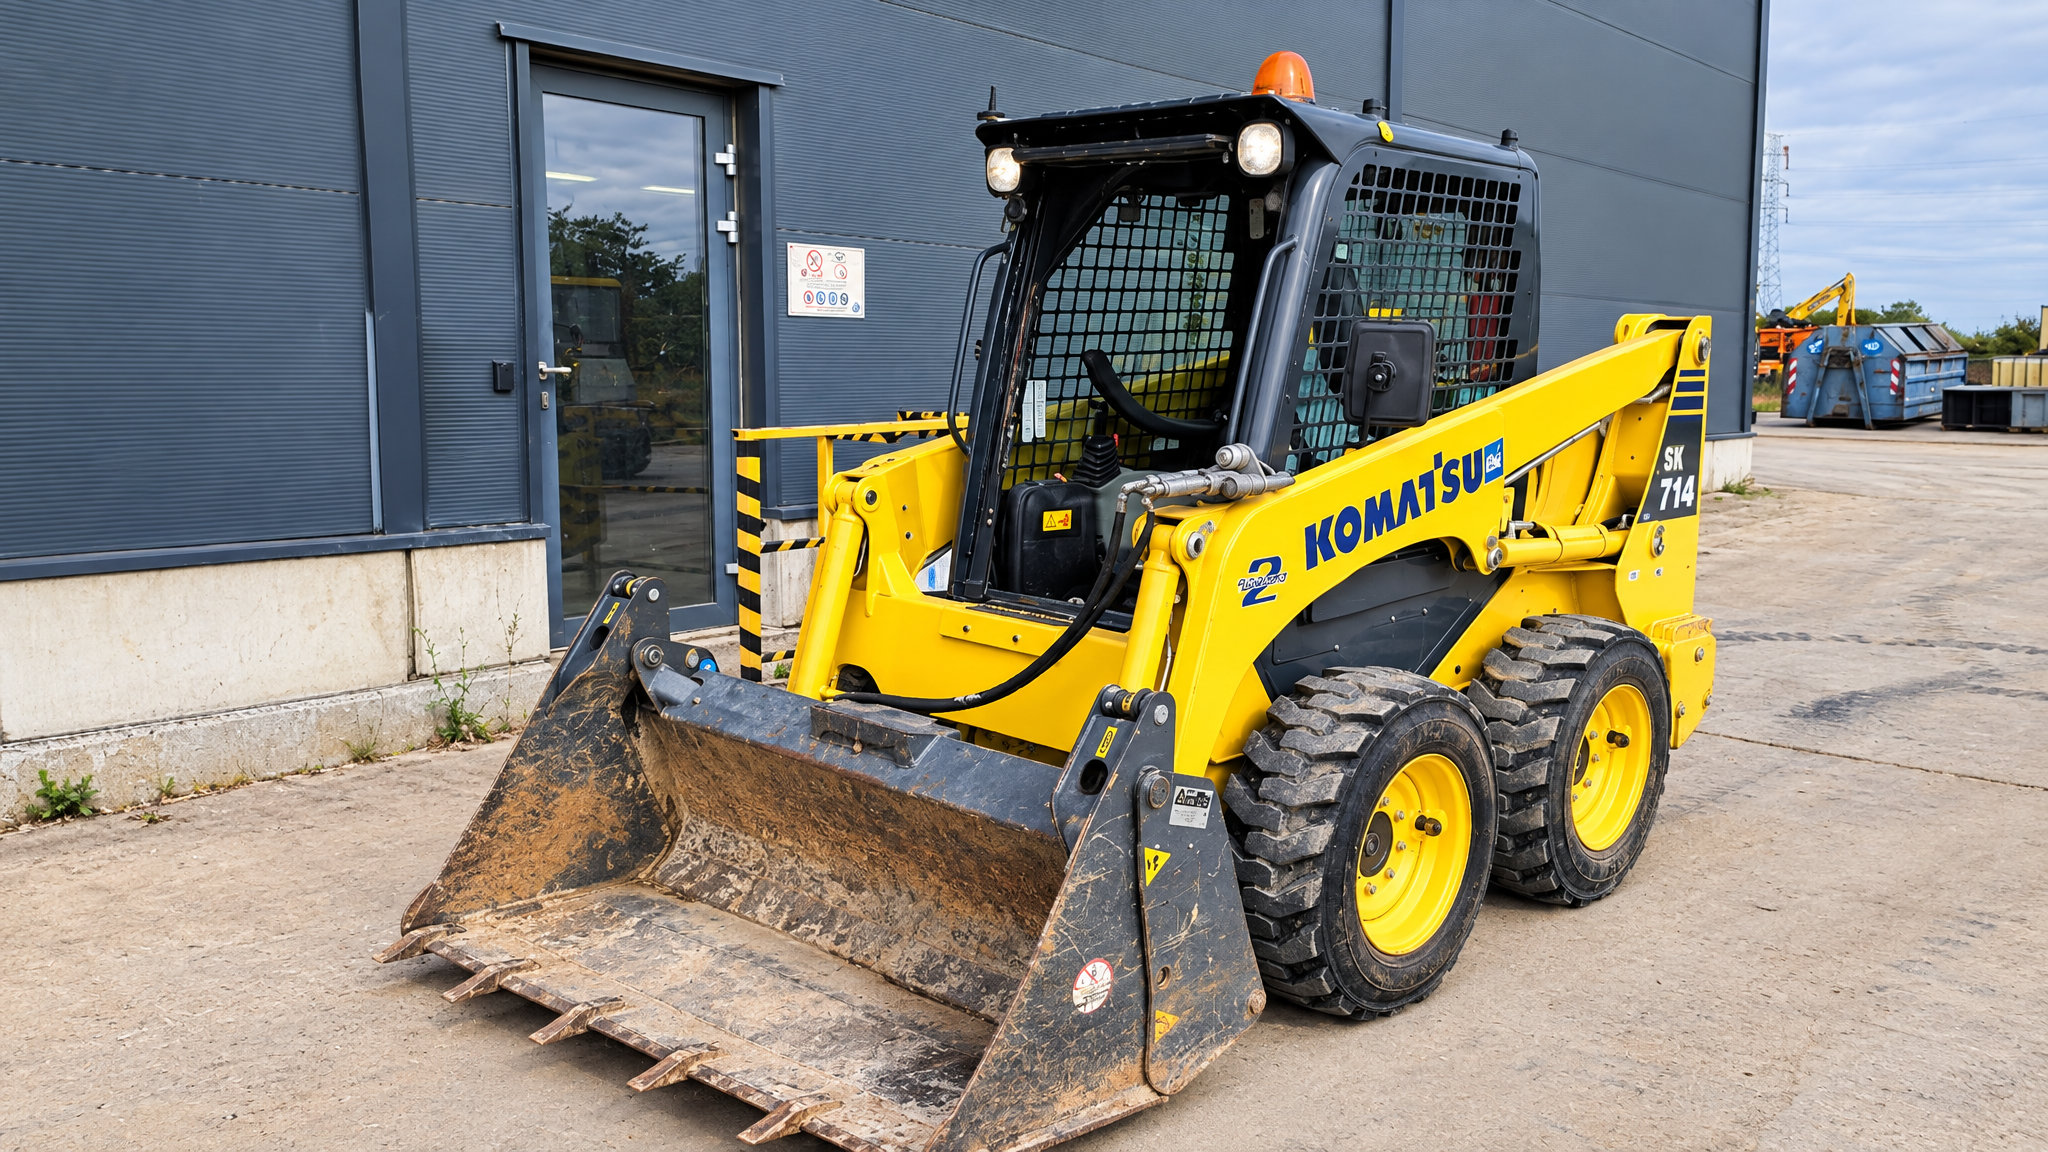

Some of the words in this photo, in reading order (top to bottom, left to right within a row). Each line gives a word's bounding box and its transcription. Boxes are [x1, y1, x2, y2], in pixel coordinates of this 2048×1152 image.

[1663, 445, 1685, 471] SK
[1304, 448, 1483, 571] KOMATSU
[1659, 475, 1695, 511] 714
[1242, 555, 1282, 607] 2
